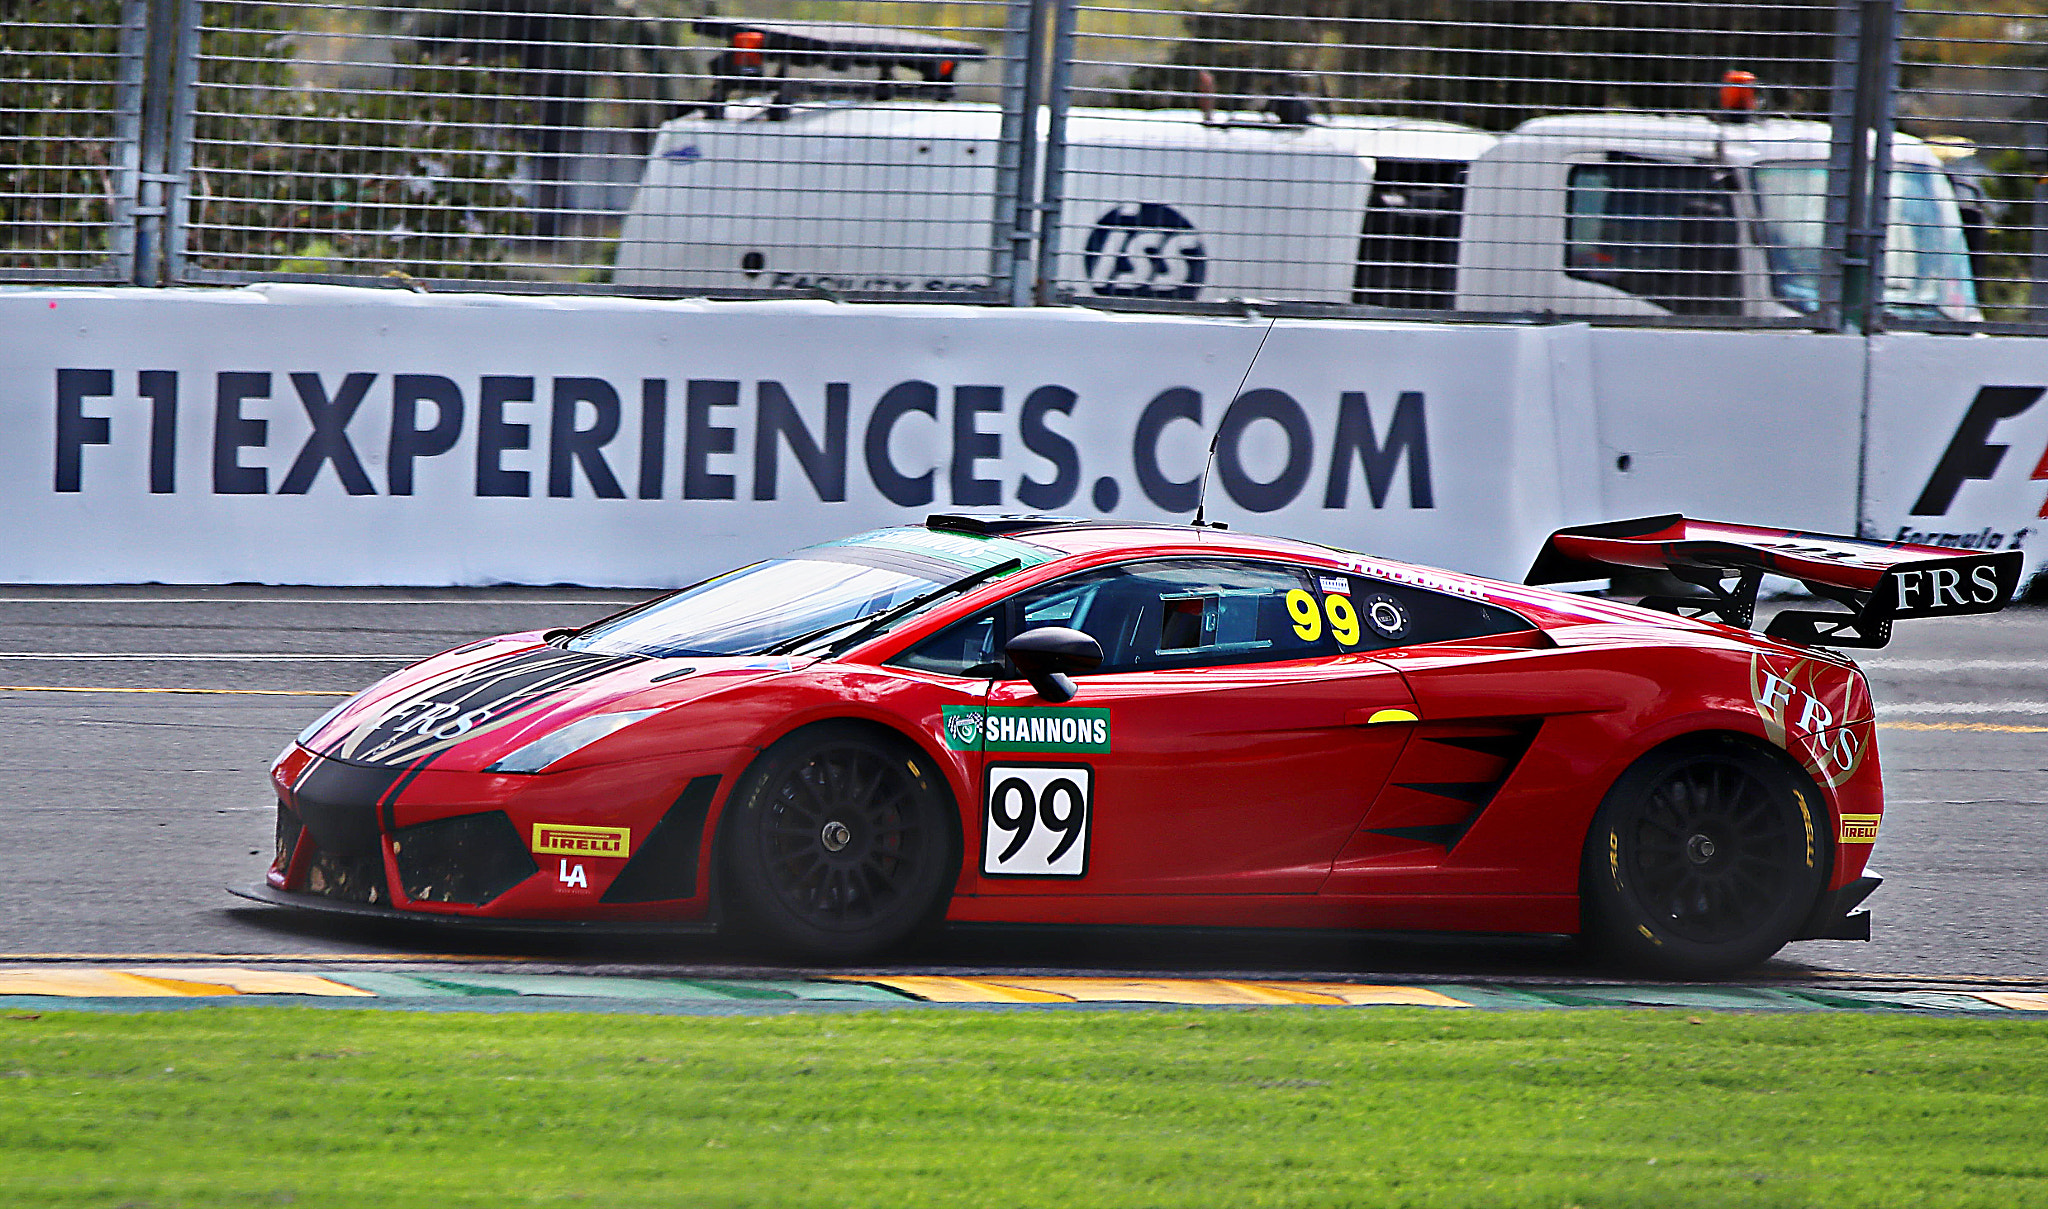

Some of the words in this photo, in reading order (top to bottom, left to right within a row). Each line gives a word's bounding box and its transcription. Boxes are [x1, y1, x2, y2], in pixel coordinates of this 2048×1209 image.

[1891, 565, 1999, 611] FRS
[1286, 588, 1361, 646] 99
[364, 700, 495, 740] FRS
[985, 716, 1108, 744] SHANNONS
[1757, 668, 1860, 772] FRS
[540, 829, 622, 852] PIRELLI
[991, 776, 1086, 865] 99
[1841, 819, 1879, 838] PIRELLI
[559, 858, 588, 889] LA
